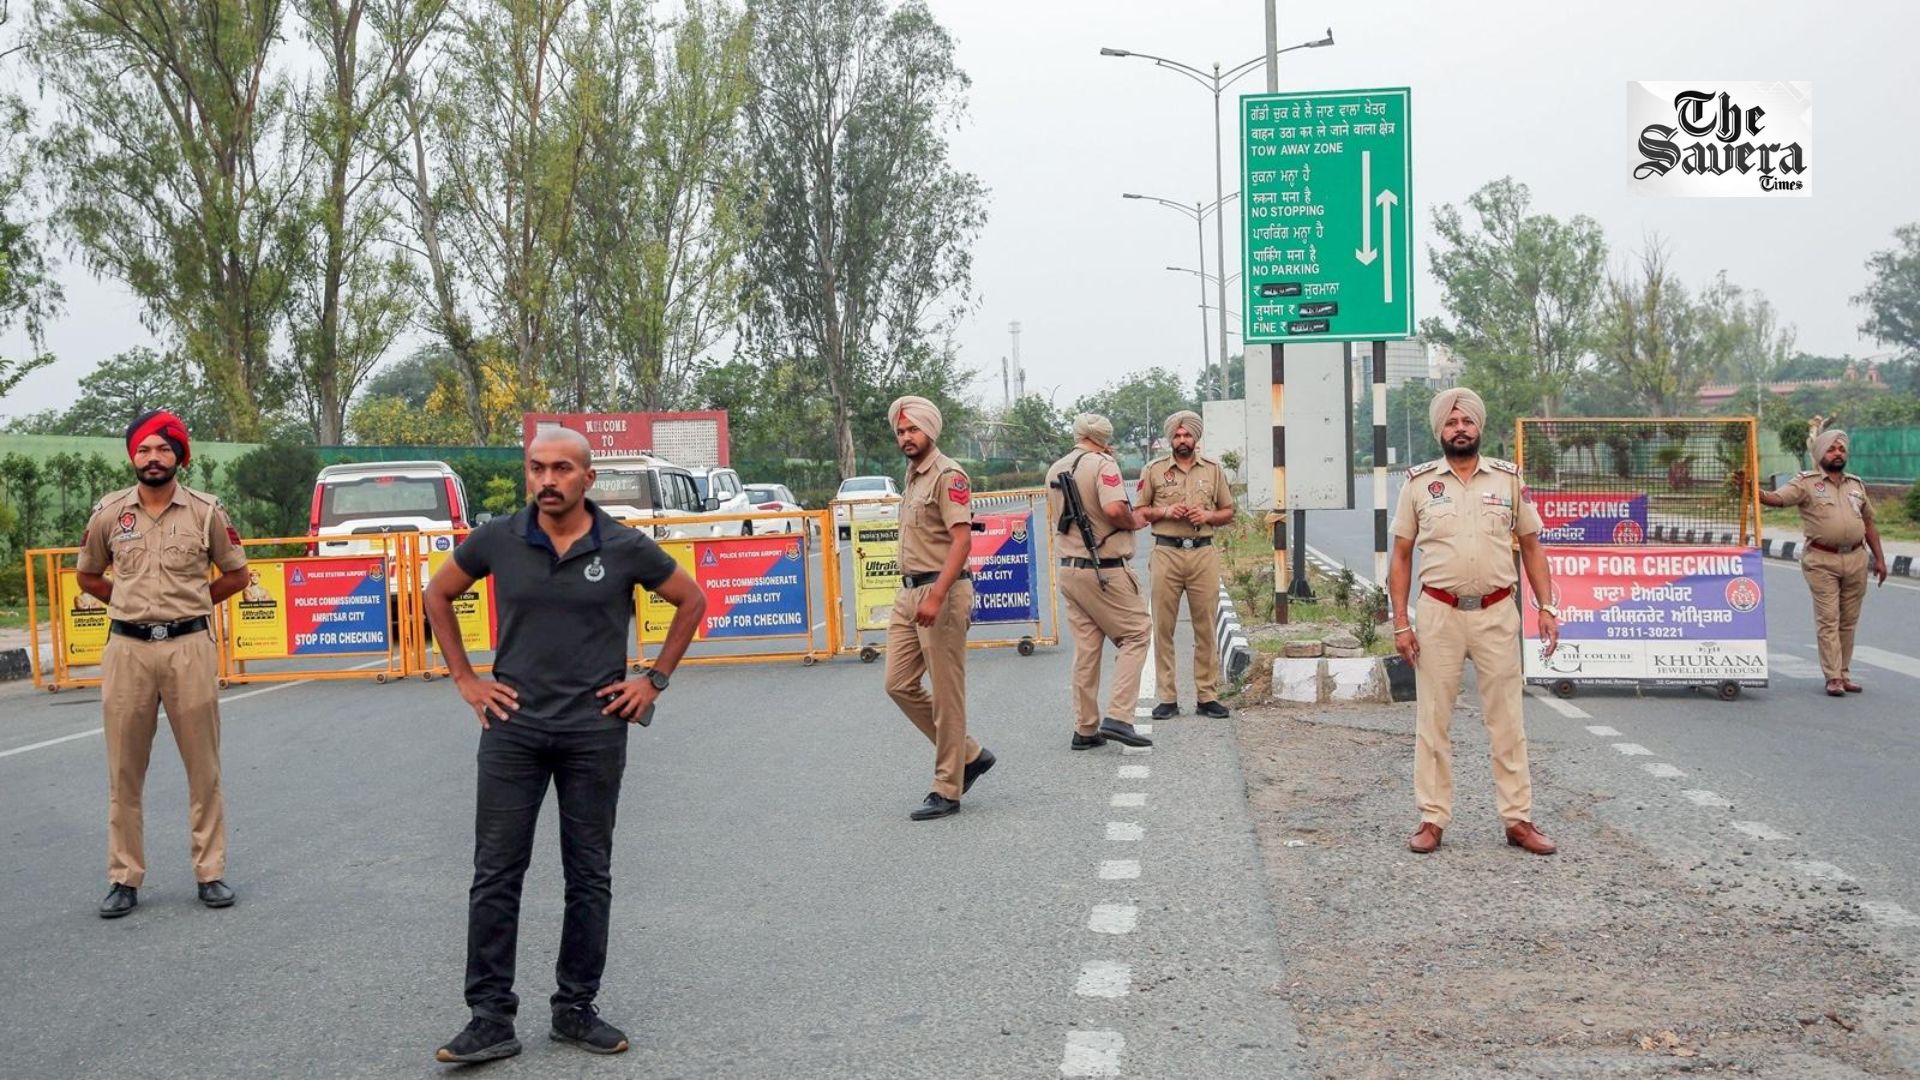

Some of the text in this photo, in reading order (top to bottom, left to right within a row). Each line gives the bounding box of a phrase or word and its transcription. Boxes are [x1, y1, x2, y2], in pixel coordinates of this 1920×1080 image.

[1292, 102, 1300, 119] ਕੇ
[1304, 101, 1312, 118] ਲੈ
[1251, 118, 1396, 141] वाहन उठा कर ले जाने वाला क्षेत्र
[1251, 142, 1343, 157] TOW AWAY ZONE
[1302, 163, 1311, 181] ਹੈ
[1281, 191, 1300, 203] मना
[1304, 186, 1311, 204] है
[1252, 205, 1324, 218] NO STOPPING
[1316, 221, 1324, 238] ਹੈ
[1286, 249, 1305, 261] मना
[1309, 244, 1316, 262] है
[1253, 263, 1319, 276] NO PARKING
[1253, 322, 1276, 333] FINE
[585, 420, 627, 433] WELCOME
[601, 435, 614, 447] TO
[1544, 501, 1630, 519] CHECKING
[866, 560, 899, 571] UltraTe
[1597, 556, 1637, 576] FOR
[1642, 555, 1744, 576] CHECKING
[706, 575, 797, 588] POLICE COMMISSIONERATE
[972, 570, 1013, 581] TSAR CITY
[1592, 581, 1692, 601] ਥਾਣਾ ਏਅਰਪੋਰਟ
[295, 595, 380, 607] POLICE COMMISSIONERATE
[725, 592, 781, 604] AMRITSAR CITY
[984, 592, 1030, 609] CHECKING
[311, 611, 365, 622] AMRITSAR CITY
[707, 613, 802, 629] STOP FOR CHECKING
[294, 631, 384, 645] STOP FOR CHECKING
[1607, 627, 1683, 638] 97811-30221
[1654, 655, 1764, 667] KHURANA
